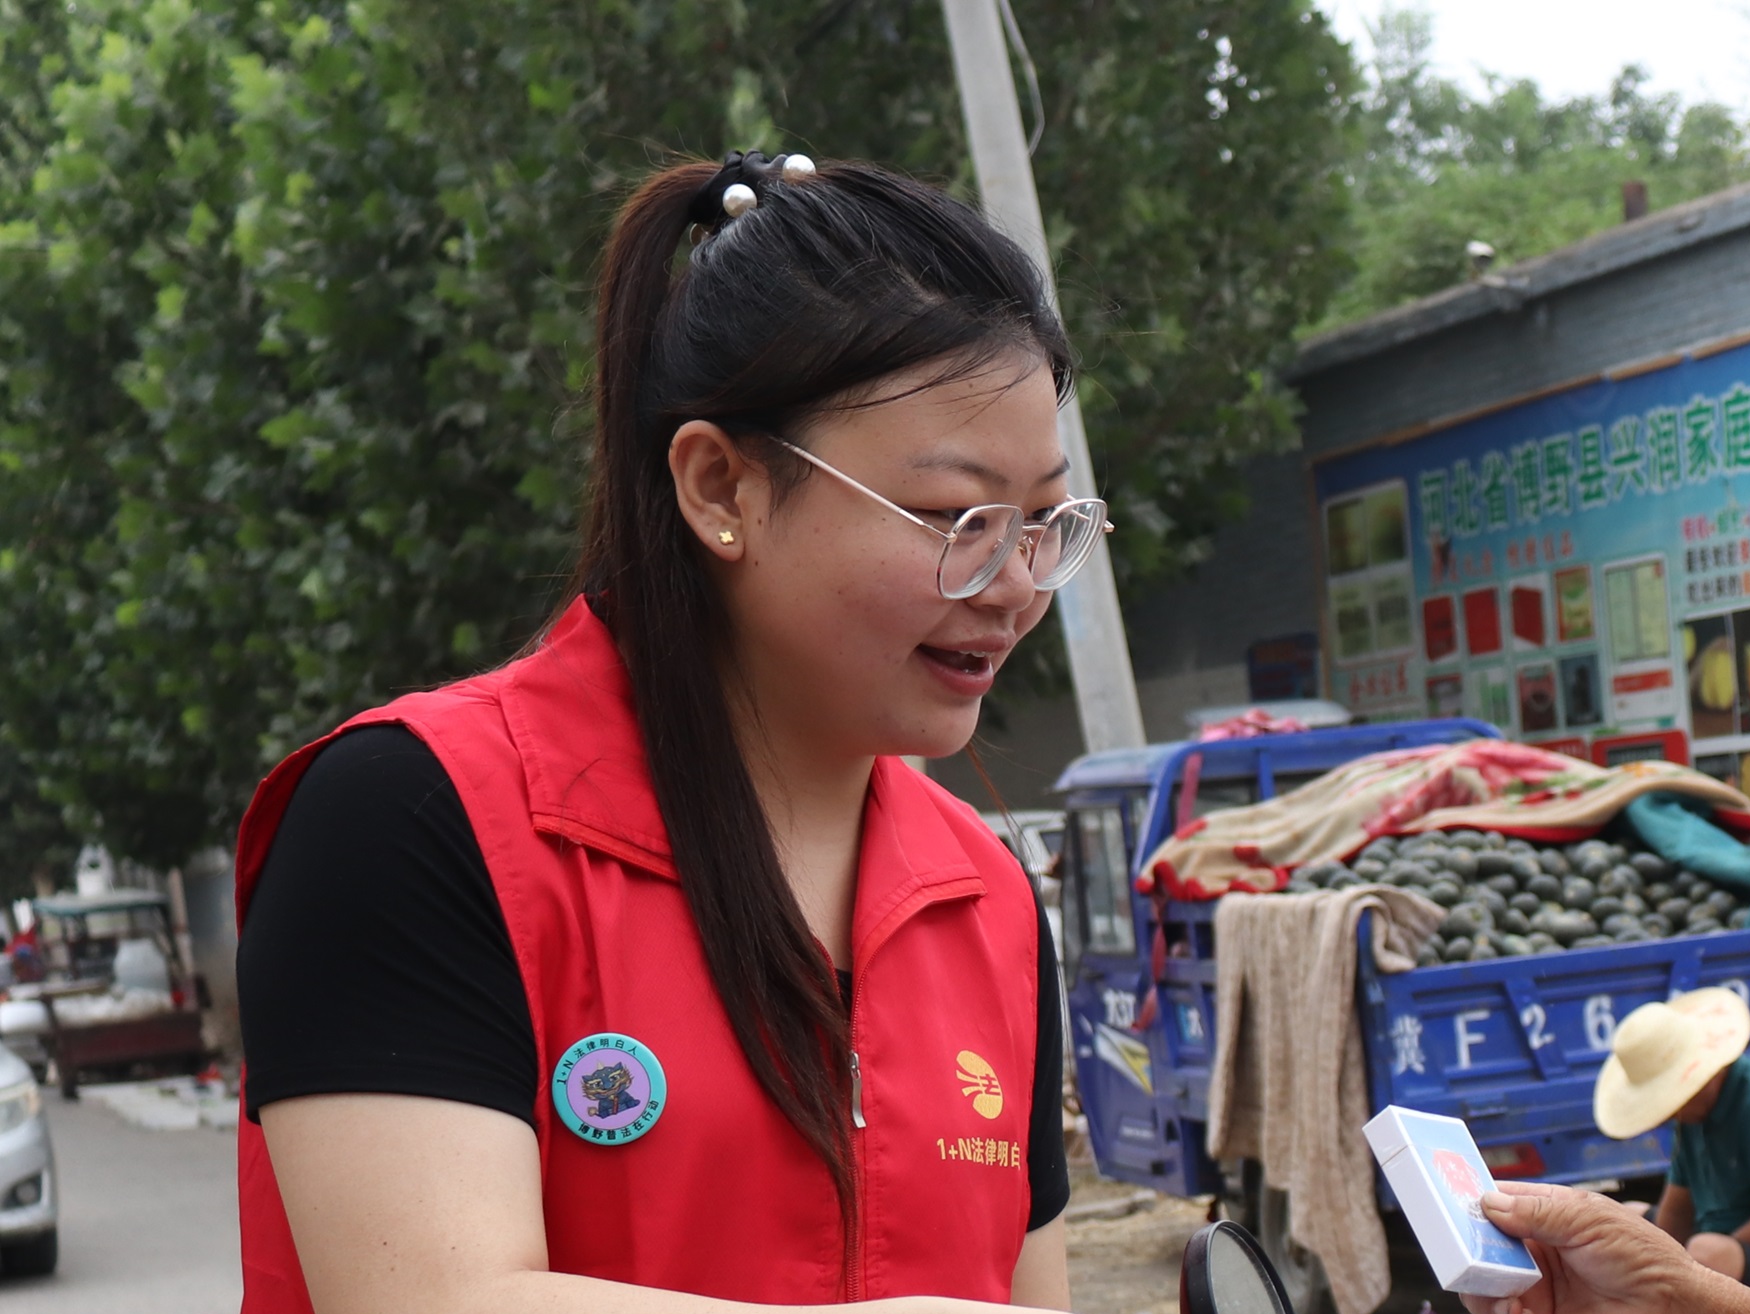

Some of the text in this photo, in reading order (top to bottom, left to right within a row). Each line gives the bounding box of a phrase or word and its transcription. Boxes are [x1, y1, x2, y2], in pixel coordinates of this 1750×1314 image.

[557, 1038, 638, 1085] 1+N法律明白人
[578, 1100, 659, 1141] 博野普法在行动
